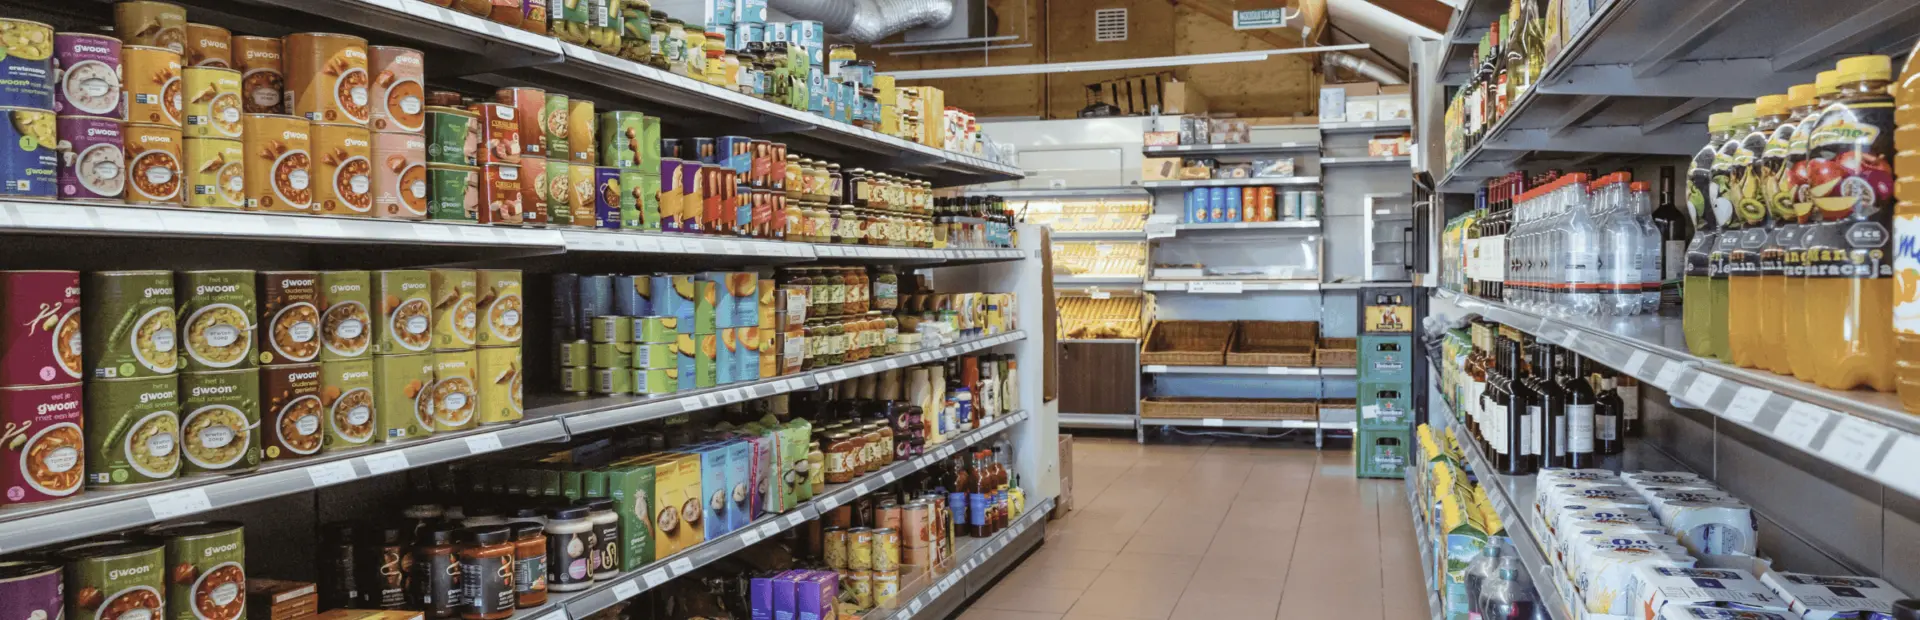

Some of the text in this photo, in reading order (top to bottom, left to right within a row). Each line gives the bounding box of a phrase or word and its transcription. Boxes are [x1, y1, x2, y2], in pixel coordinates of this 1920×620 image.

[74, 44, 106, 54] gwoon
[200, 39, 228, 49] gwoon
[246, 49, 280, 59] gwoon
[87, 128, 116, 137] gwoon
[283, 130, 308, 140] gwoon
[141, 135, 171, 143] gwoon
[282, 279, 314, 289] gwoon
[331, 284, 360, 293] gwoon
[402, 282, 426, 291] gwoon
[196, 285, 236, 295] gwoon
[1376, 361, 1402, 369] Heineken
[288, 371, 319, 382] gwoon
[343, 371, 368, 381] gwoon
[192, 385, 232, 396] gwoon
[140, 390, 174, 403] gwoon
[37, 400, 77, 415] gwoon
[204, 542, 237, 556] gwoon
[109, 564, 150, 580] gwoon
